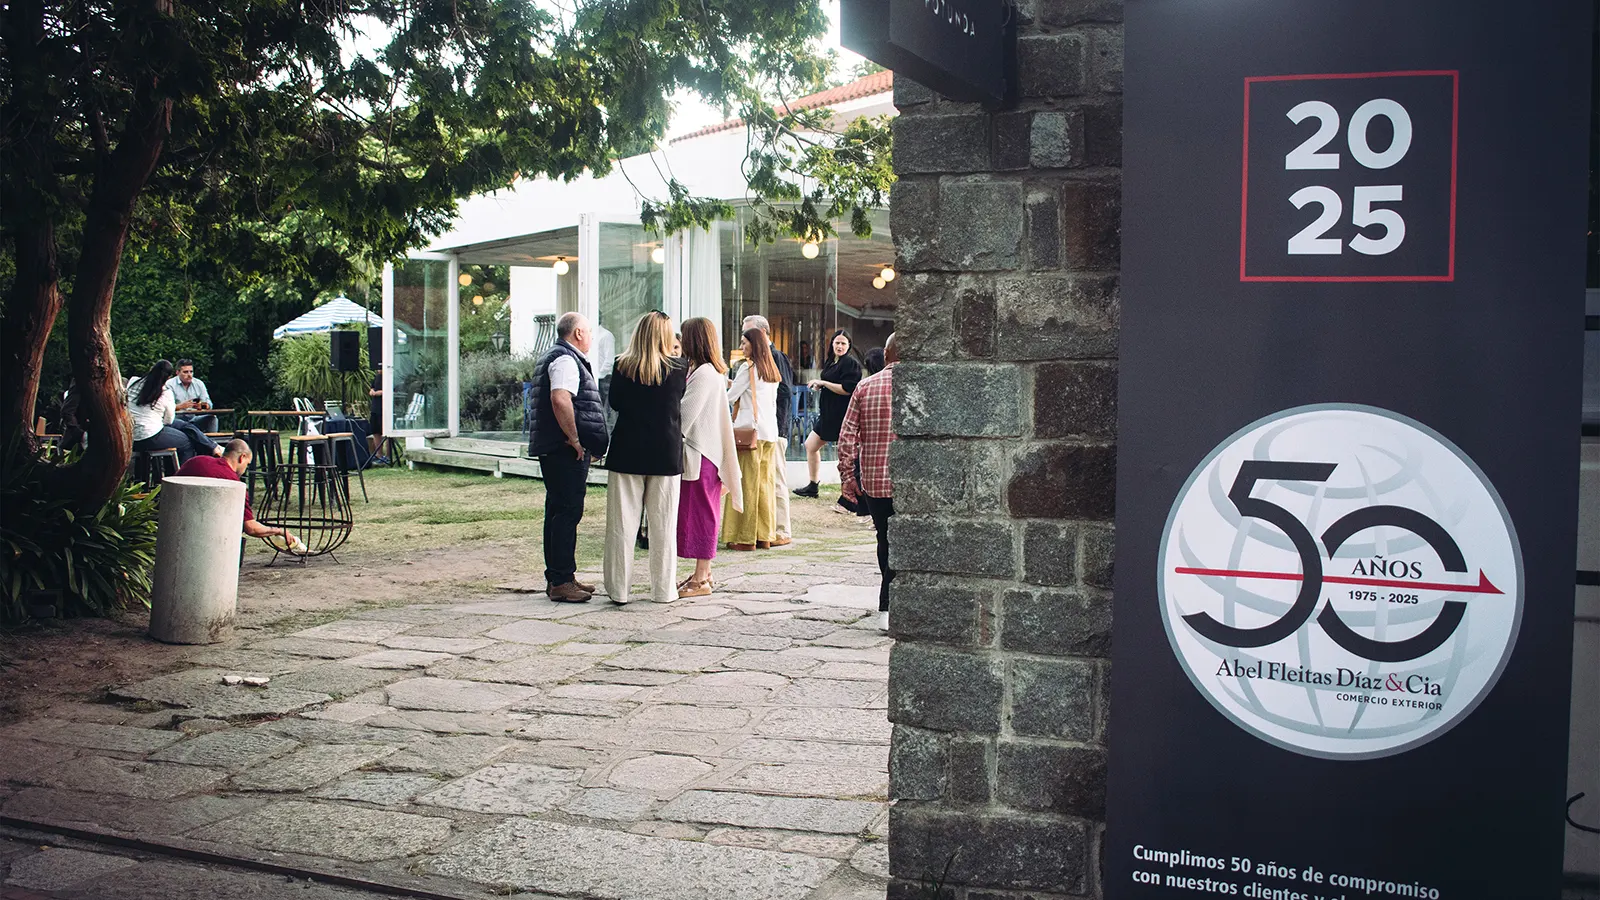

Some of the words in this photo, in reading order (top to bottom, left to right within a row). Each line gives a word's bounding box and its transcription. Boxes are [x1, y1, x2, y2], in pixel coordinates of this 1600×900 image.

[1285, 98, 1413, 170] 20
[1287, 185, 1406, 255] 25
[1181, 460, 1468, 663] 50
[1351, 555, 1423, 580] AÑOS
[1348, 590, 1377, 602] 1975
[1388, 593, 1419, 605] 2025
[1215, 658, 1263, 679] Abel
[1267, 661, 1332, 686] Fleitas
[1336, 667, 1382, 690] Díaz
[1336, 692, 1388, 706] COMERCIO
[1392, 698, 1443, 711] EXTERIOR
[1132, 844, 1226, 869] Cumplimos
[1231, 856, 1252, 873] 50
[1256, 860, 1297, 880] años
[1302, 866, 1324, 884] de
[1329, 873, 1440, 900] compromiso
[1132, 869, 1161, 885] con
[1165, 874, 1239, 896] nuestros
